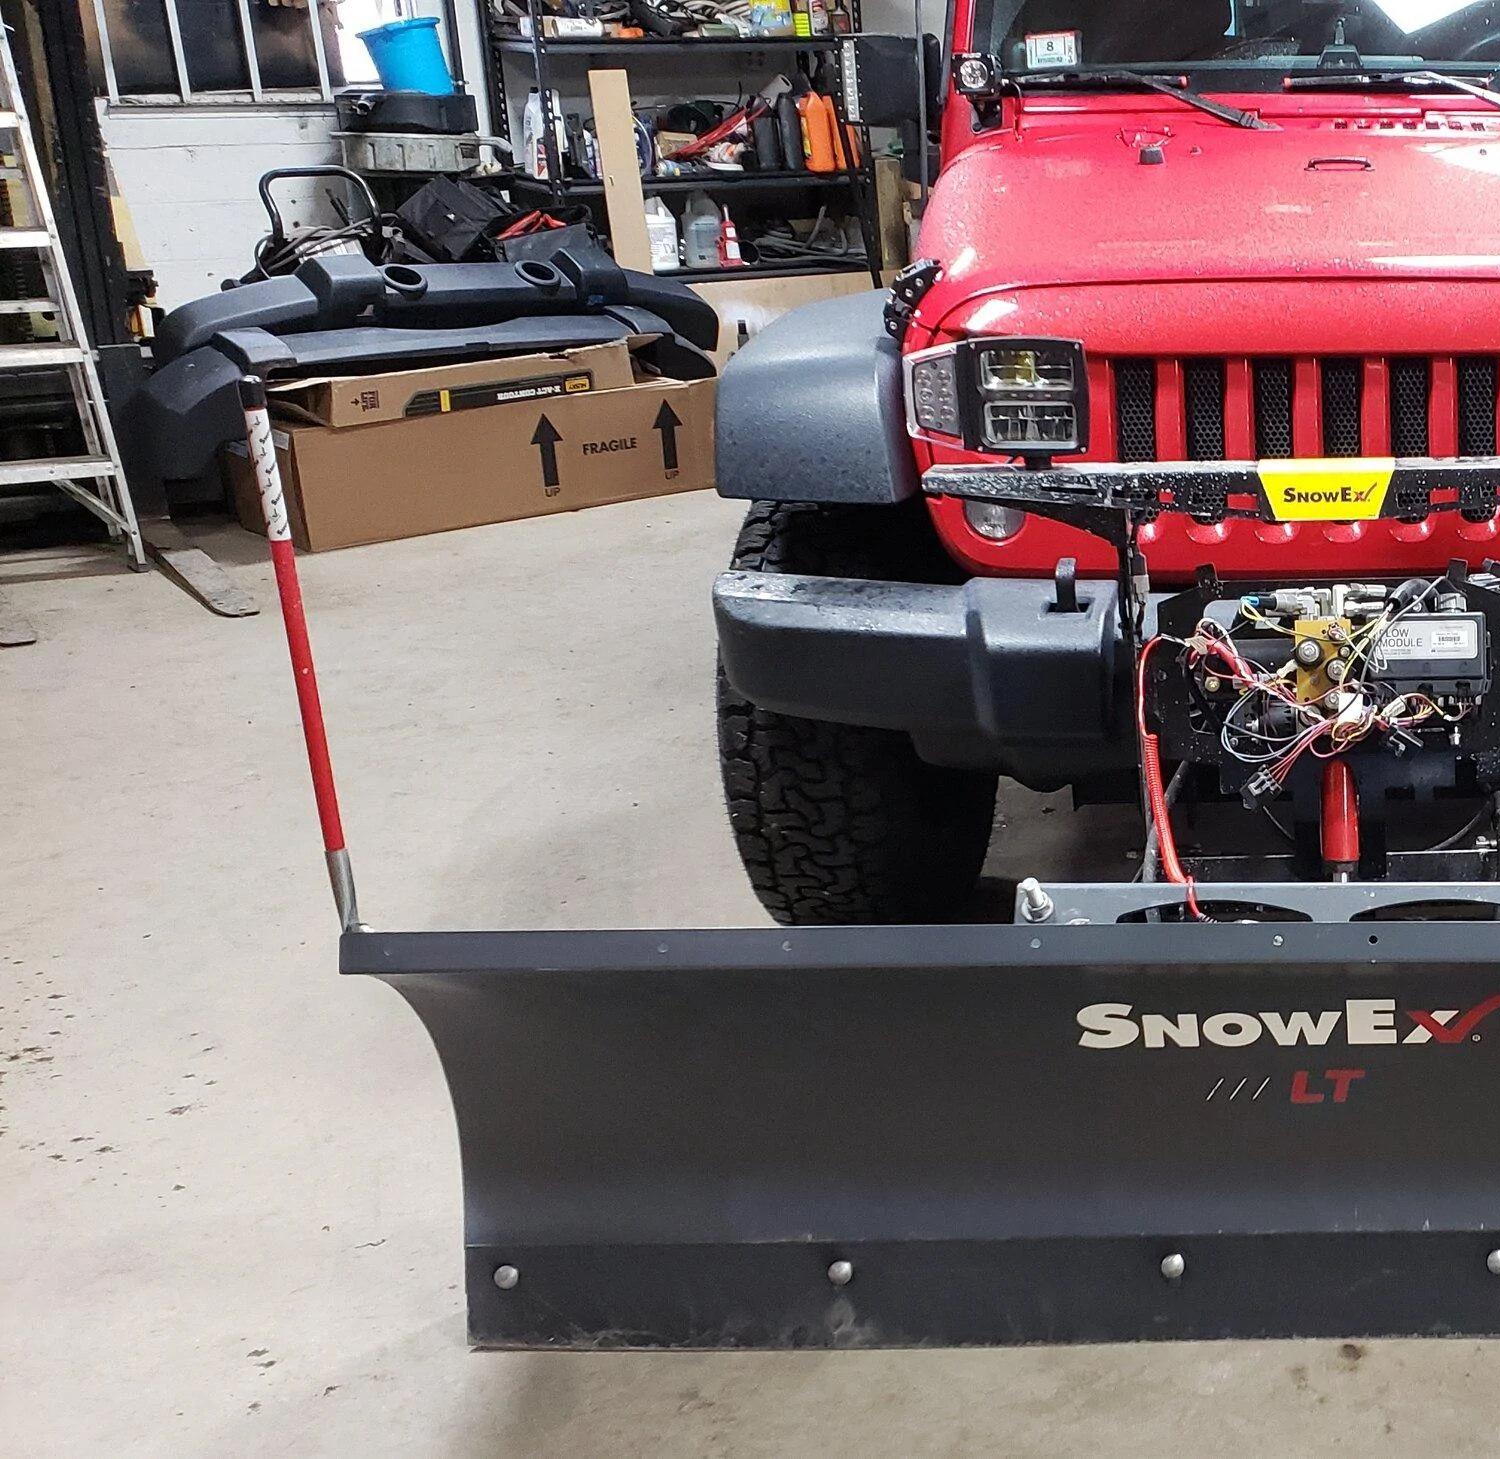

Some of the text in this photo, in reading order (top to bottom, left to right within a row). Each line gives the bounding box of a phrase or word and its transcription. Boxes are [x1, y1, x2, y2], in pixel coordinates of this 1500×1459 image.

[1046, 41, 1054, 51] 8
[582, 437, 638, 455] FRAGILE
[664, 469, 680, 480] UP
[544, 487, 561, 498] UP
[1290, 1069, 1366, 1104] LT
